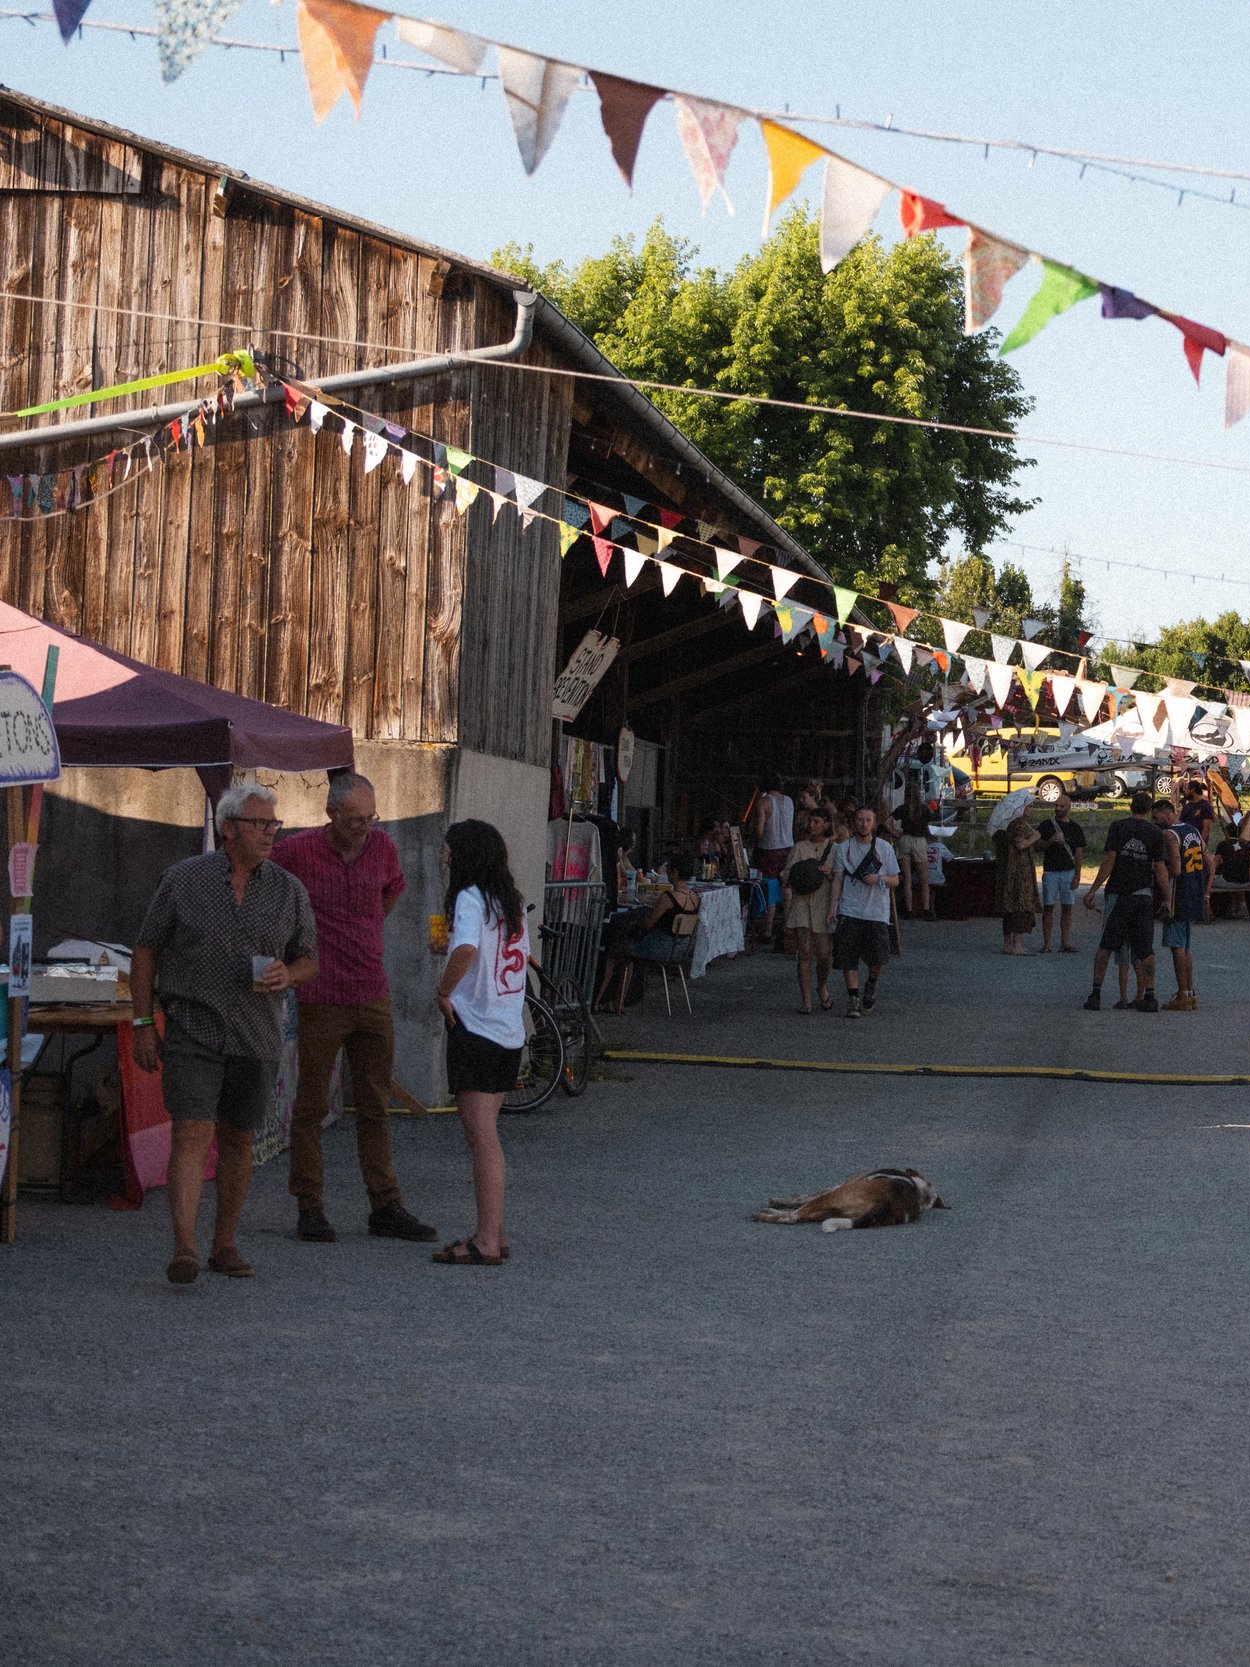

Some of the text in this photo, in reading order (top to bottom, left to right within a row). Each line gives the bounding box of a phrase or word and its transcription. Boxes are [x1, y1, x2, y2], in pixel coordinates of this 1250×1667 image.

[570, 648, 604, 675] STAND
[0, 710, 50, 757] TONS
[1184, 847, 1203, 873] 25
